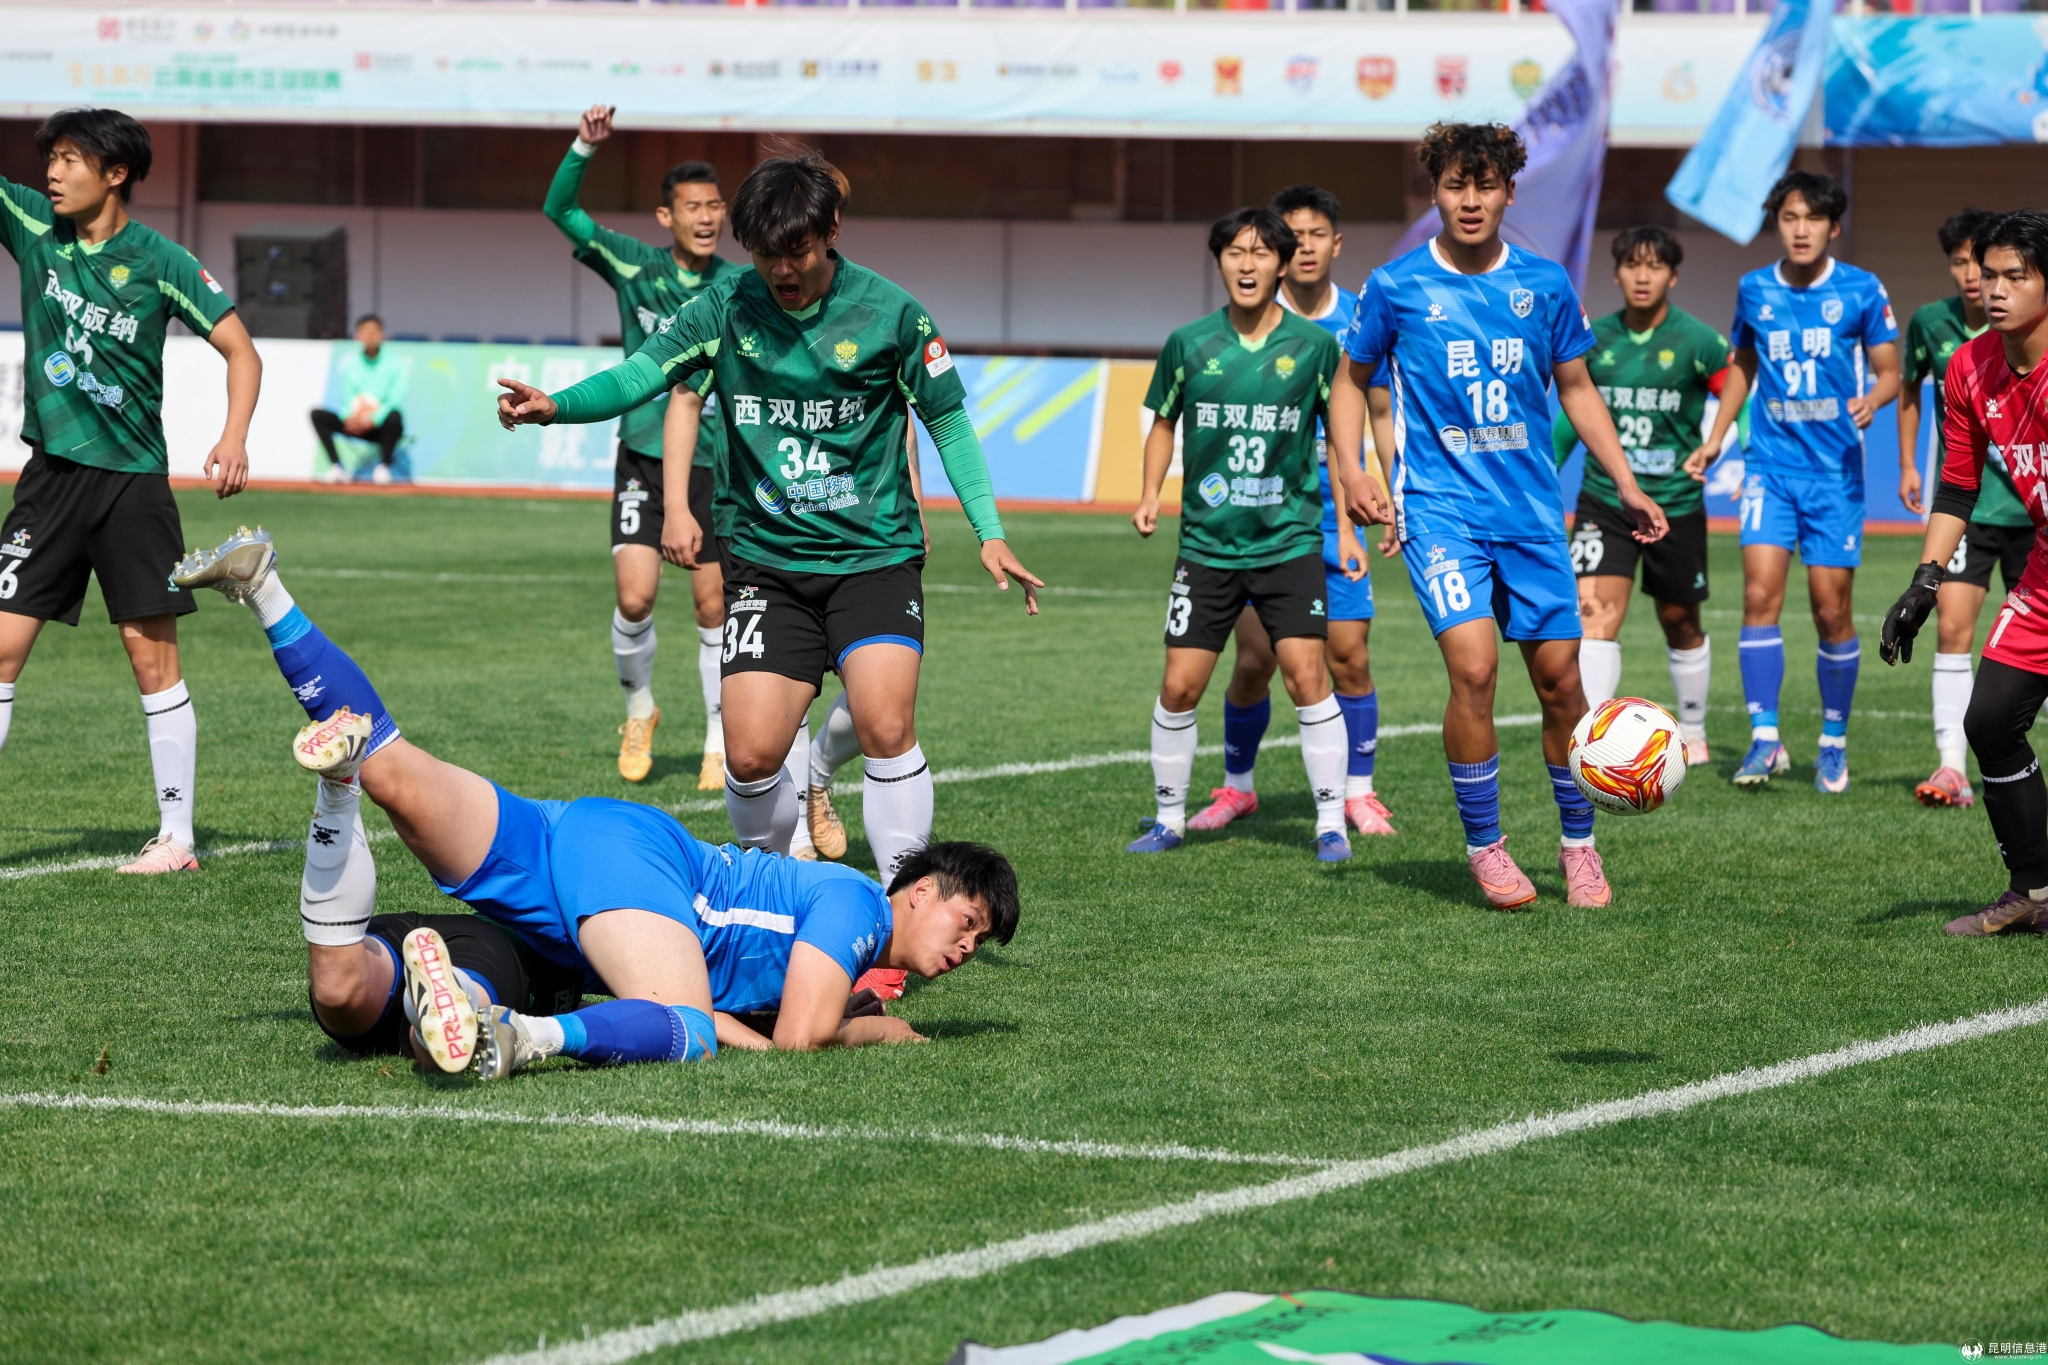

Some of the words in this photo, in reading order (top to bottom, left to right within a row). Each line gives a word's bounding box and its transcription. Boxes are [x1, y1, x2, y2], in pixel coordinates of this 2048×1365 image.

[45, 269, 139, 344] 西双版纳
[1425, 315, 1448, 323] KELME
[736, 349, 760, 358] KELME
[1446, 338, 1524, 378] 昆明
[1768, 328, 1831, 362] 昆明
[1783, 359, 1817, 397] 91
[733, 394, 867, 431] 西双版纳
[1195, 402, 1302, 433] 西双版纳
[1467, 380, 1509, 424] 18
[1618, 415, 1653, 447] 29
[777, 437, 831, 480] 34
[1228, 434, 1267, 474] 33
[786, 472, 855, 502] 中国移动
[791, 501, 828, 515] China
[828, 493, 860, 511] Mobile
[620, 500, 641, 535] 5
[1570, 538, 1604, 573] 29
[0, 555, 18, 600] 6
[1428, 571, 1471, 619] 18
[722, 614, 765, 664] 34
[1989, 608, 2015, 649] 1
[415, 930, 468, 1060] PREDATOR
